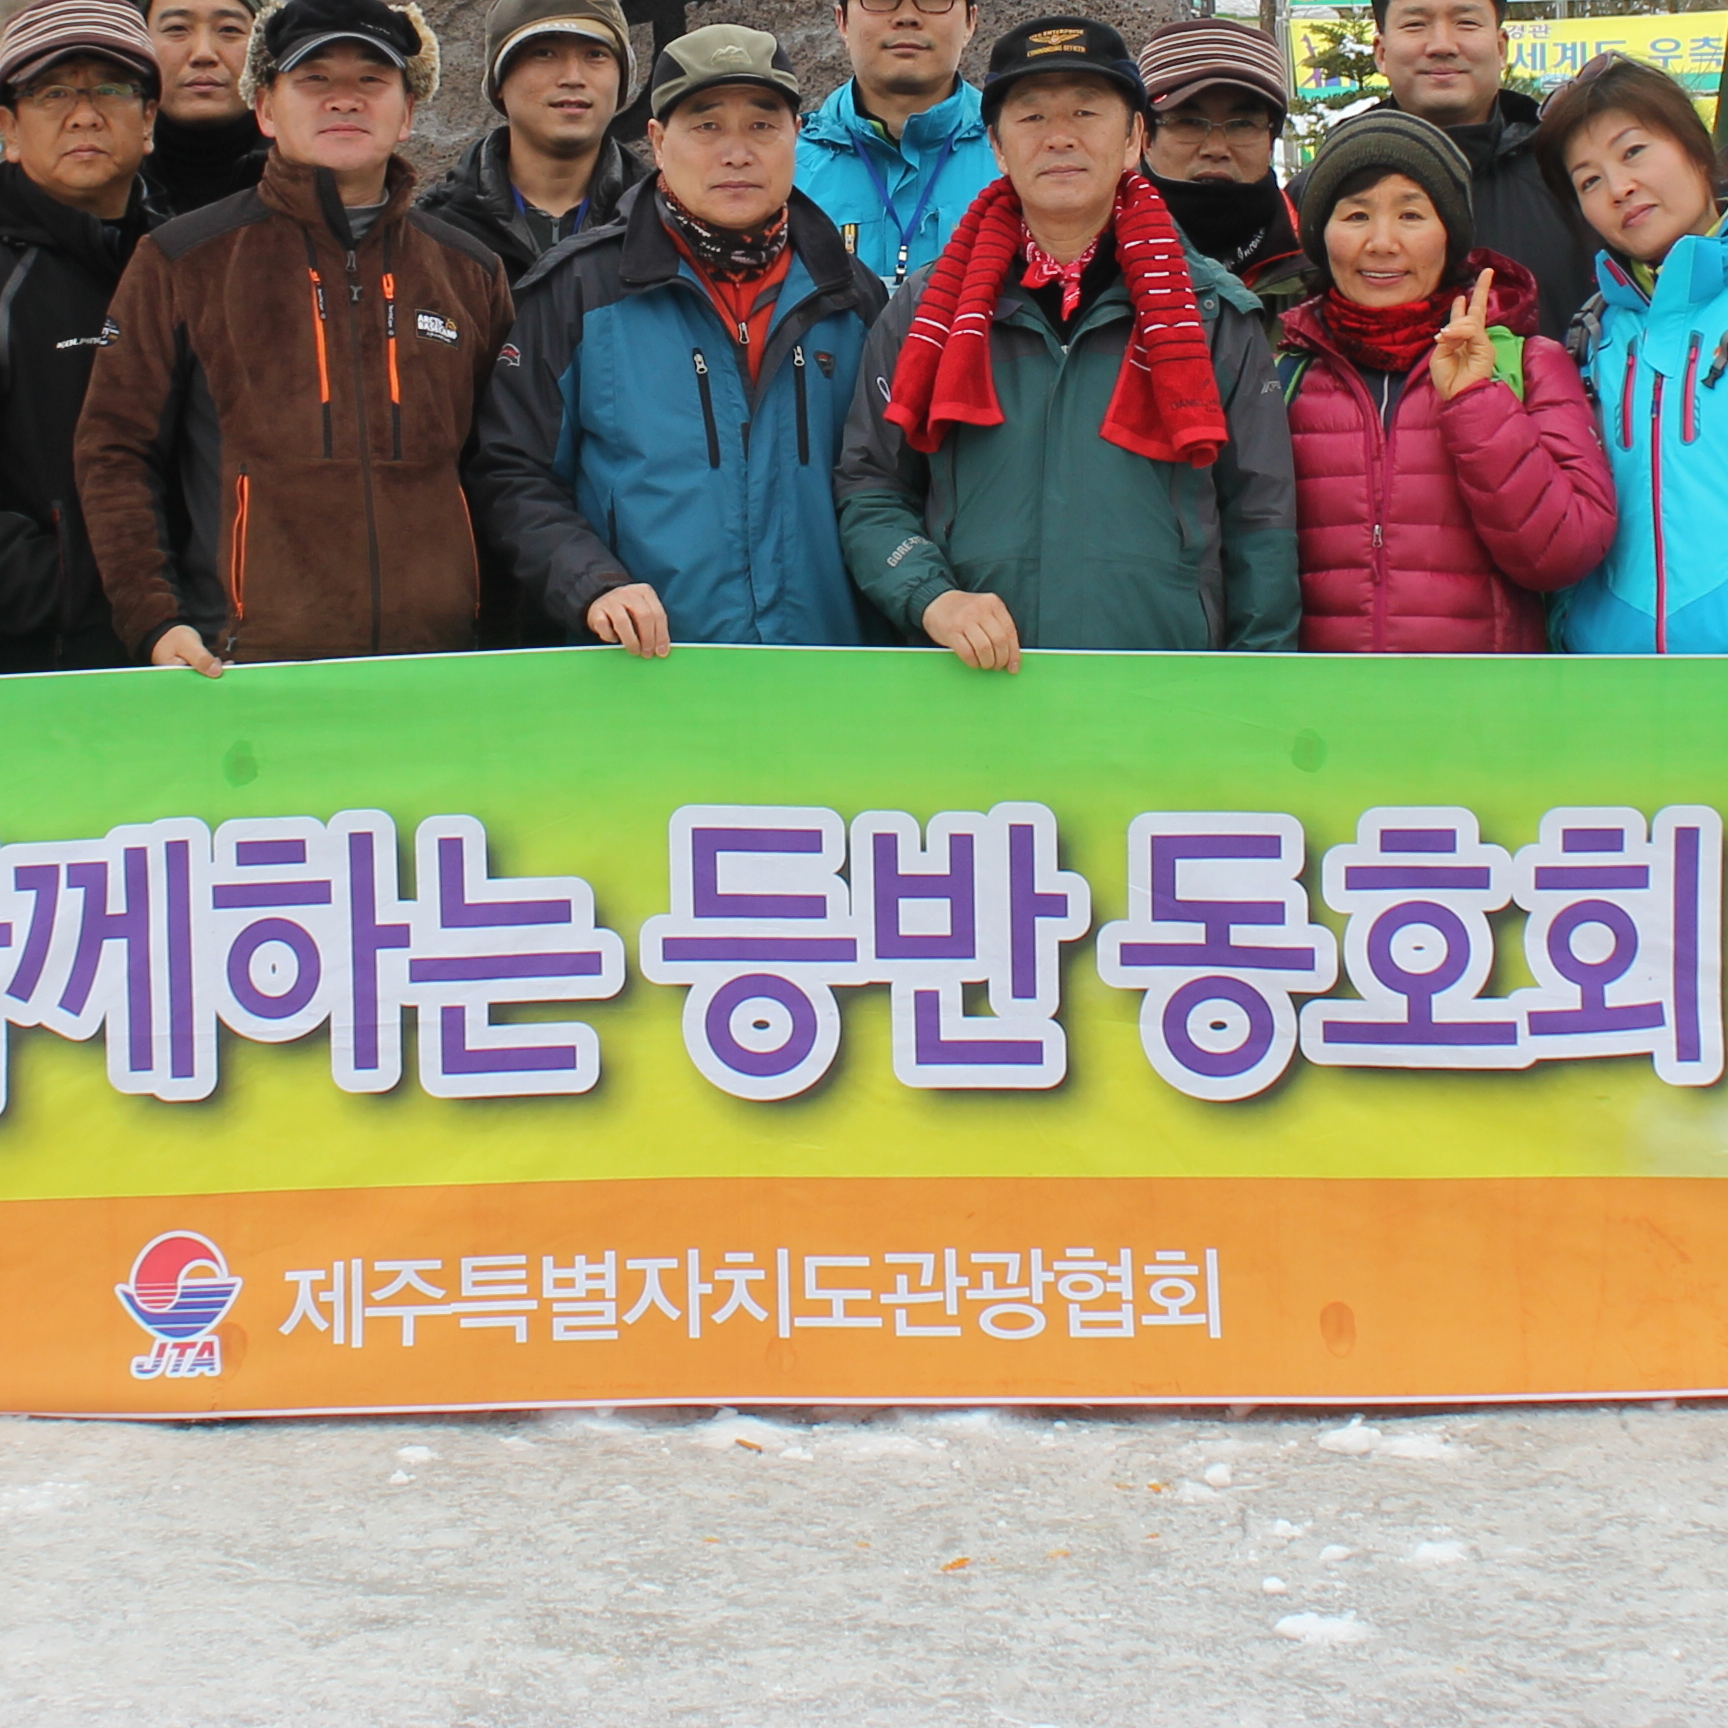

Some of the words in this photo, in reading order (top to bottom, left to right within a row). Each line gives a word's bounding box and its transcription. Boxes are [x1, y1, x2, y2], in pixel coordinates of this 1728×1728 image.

[1506, 24, 1551, 39] 경관
[641, 802, 1090, 1100] 등반
[1097, 804, 1724, 1102] 동호회
[278, 1246, 1221, 1349] 제주특별자치도관광협회
[132, 1336, 221, 1378] JTA
